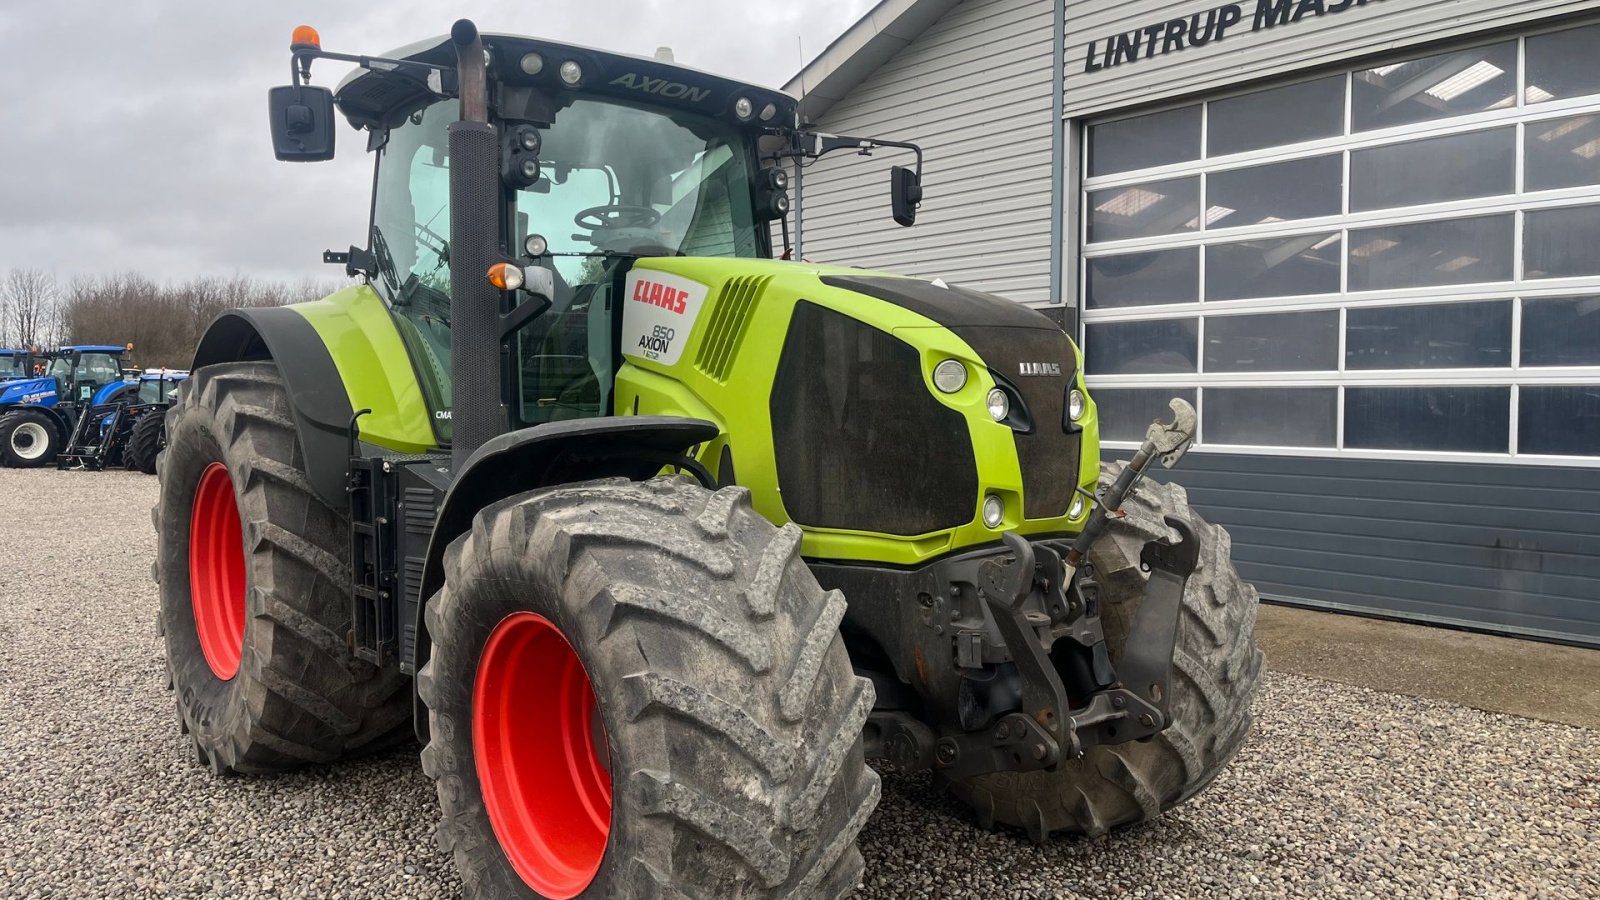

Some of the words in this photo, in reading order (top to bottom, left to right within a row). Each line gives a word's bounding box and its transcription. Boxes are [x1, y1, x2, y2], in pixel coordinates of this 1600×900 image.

[1084, 4, 1241, 72] LINTRUP
[608, 73, 711, 102] AXION
[633, 280, 688, 315] CLAAS
[652, 325, 675, 341] 850
[638, 335, 669, 354] AXION
[1019, 362, 1061, 376] CLAAS
[435, 411, 453, 420] CMA
